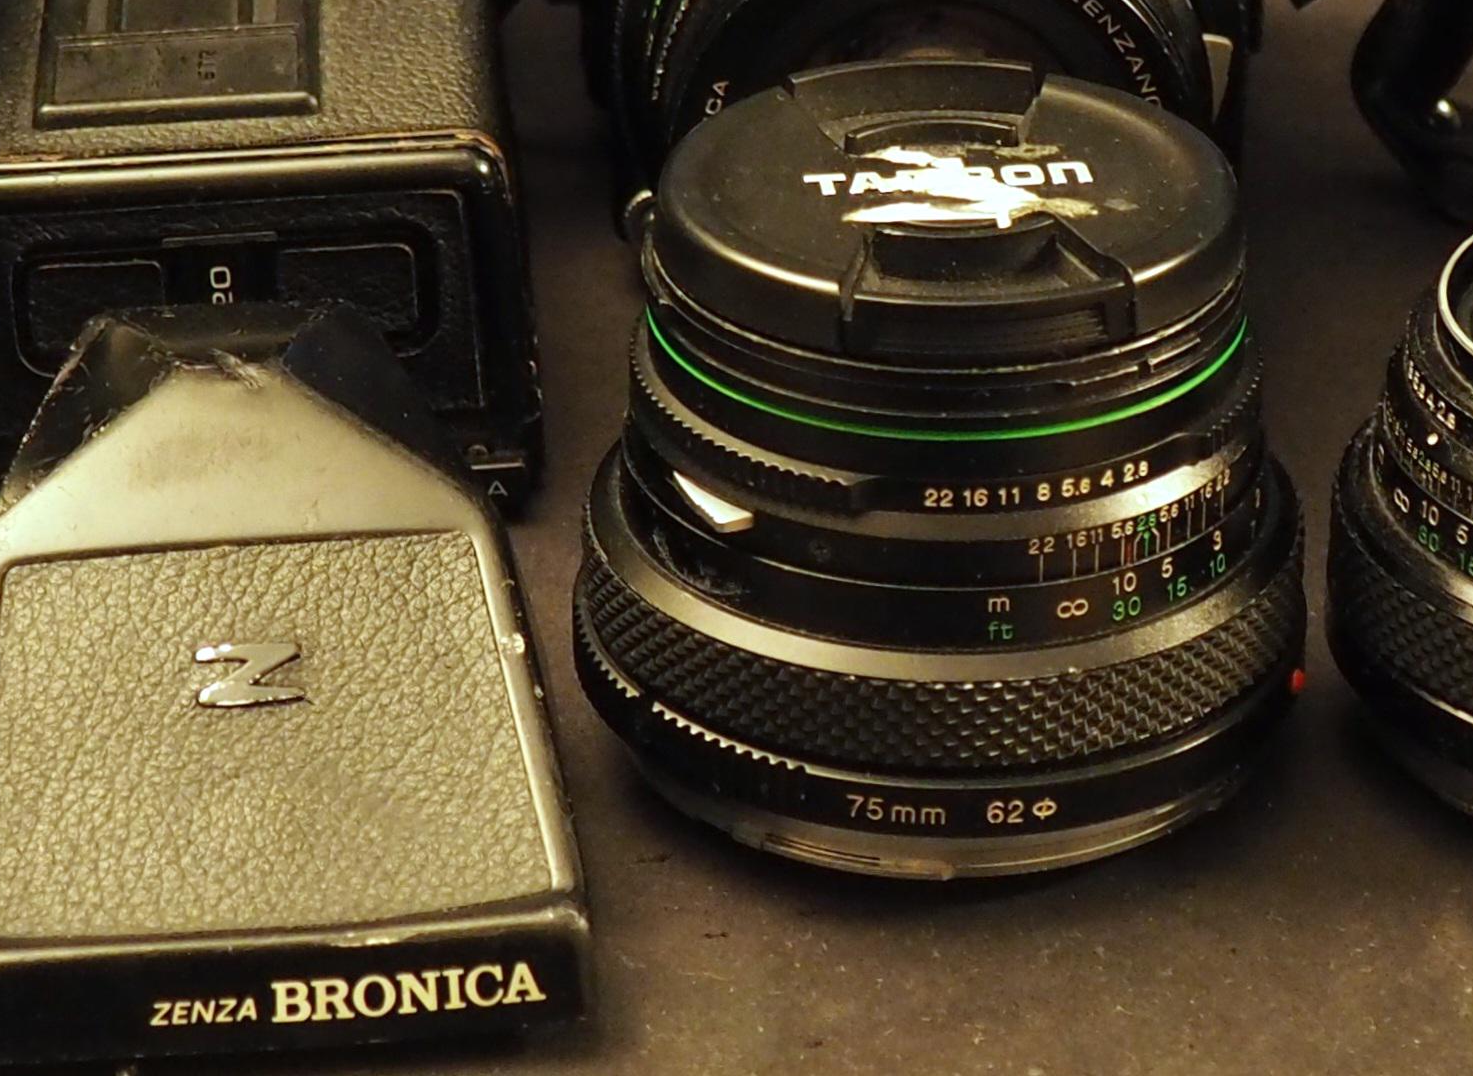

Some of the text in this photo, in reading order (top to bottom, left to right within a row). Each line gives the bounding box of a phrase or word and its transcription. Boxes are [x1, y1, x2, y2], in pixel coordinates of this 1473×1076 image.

[923, 460, 1149, 508] 22 16 11 8 5.6 4 2.8
[1111, 519, 1136, 540] 5.6
[1421, 500, 1441, 527] 10
[1456, 524, 1470, 546] 5
[987, 594, 1012, 614] m
[1112, 572, 1138, 595] 10
[1160, 556, 1174, 580] 5
[987, 620, 1014, 641] ft
[1111, 594, 1143, 622] 30
[1209, 553, 1227, 579] 10
[845, 793, 947, 827] 75mm
[150, 961, 548, 1027] ZENZA BRONICA
